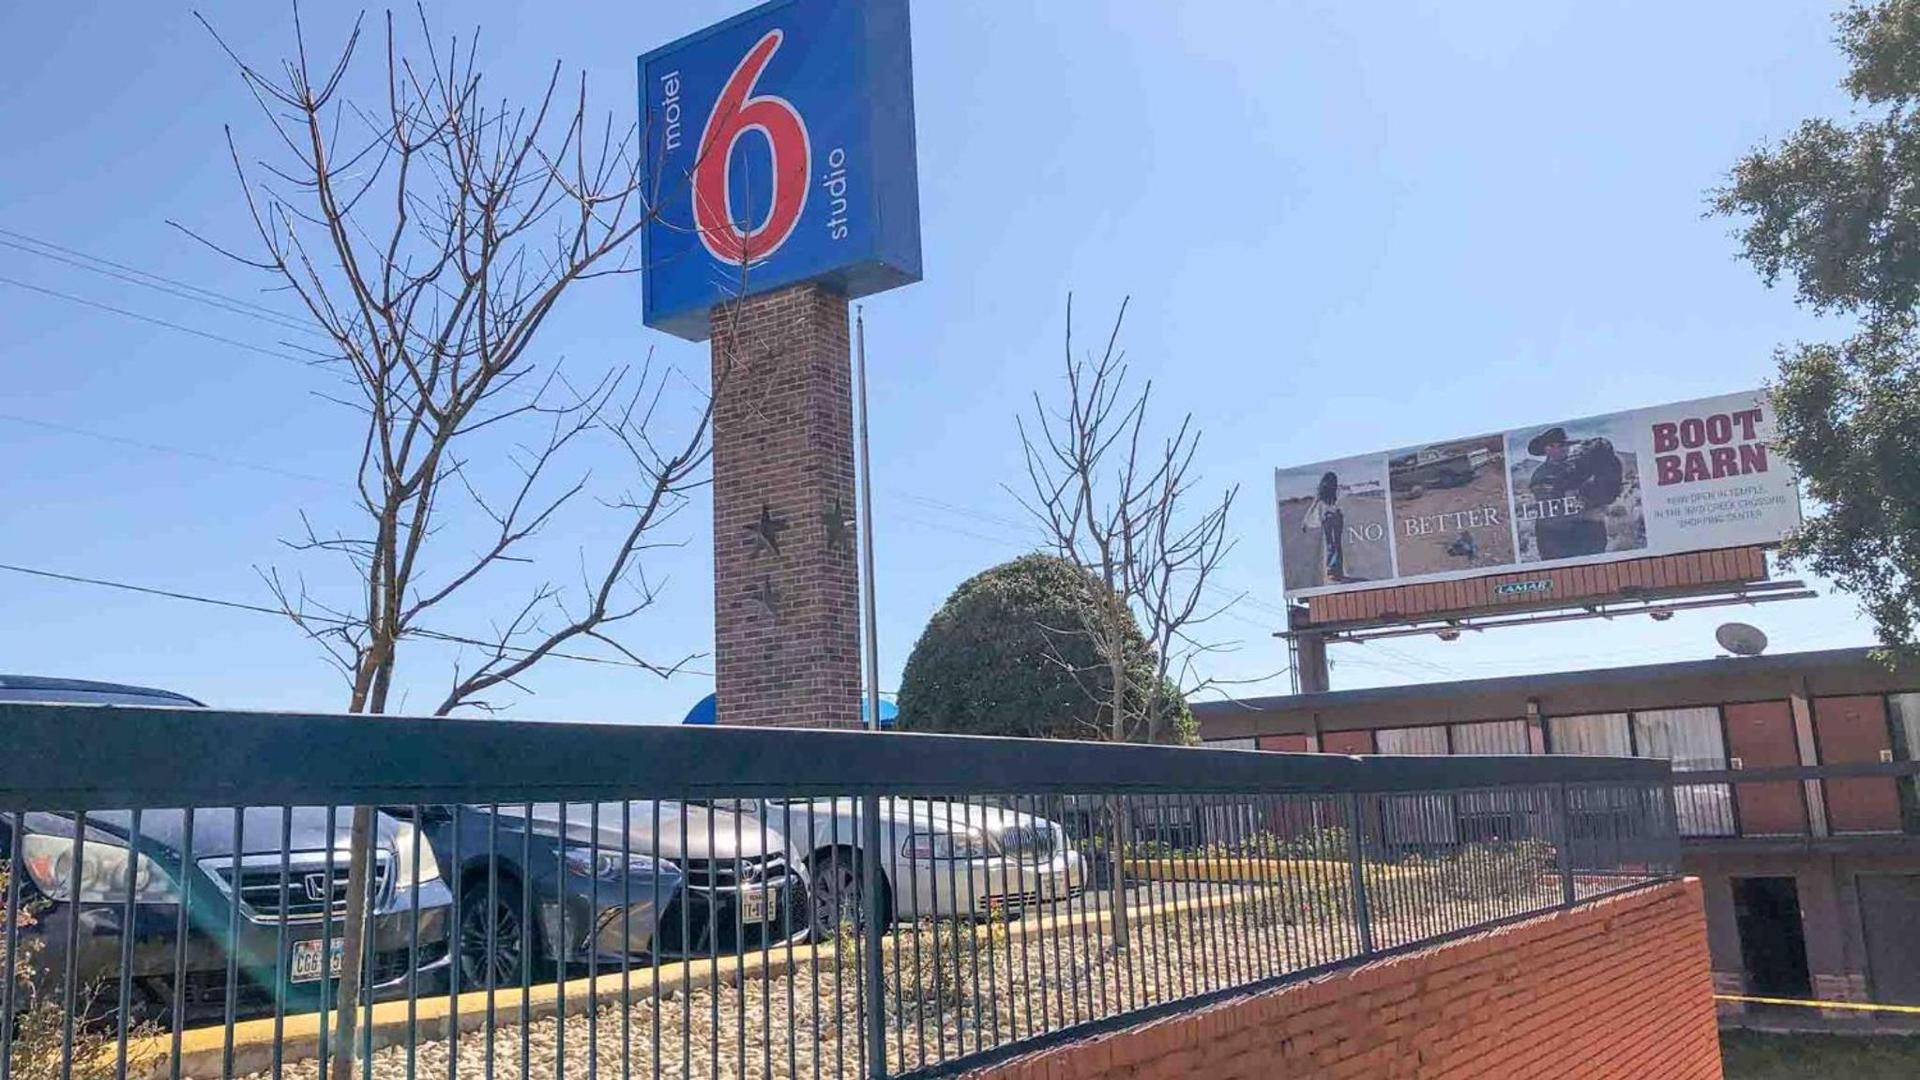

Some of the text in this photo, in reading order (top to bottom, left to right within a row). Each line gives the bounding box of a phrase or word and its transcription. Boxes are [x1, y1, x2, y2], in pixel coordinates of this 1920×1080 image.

[660, 70, 681, 150] motel
[691, 27, 812, 266] 6
[823, 147, 848, 240] studio
[1652, 408, 1763, 454] BOOT
[1655, 444, 1768, 486] BARN
[1348, 496, 1580, 544] NO BETTER LIFE
[1498, 580, 1546, 594] LAMAR
